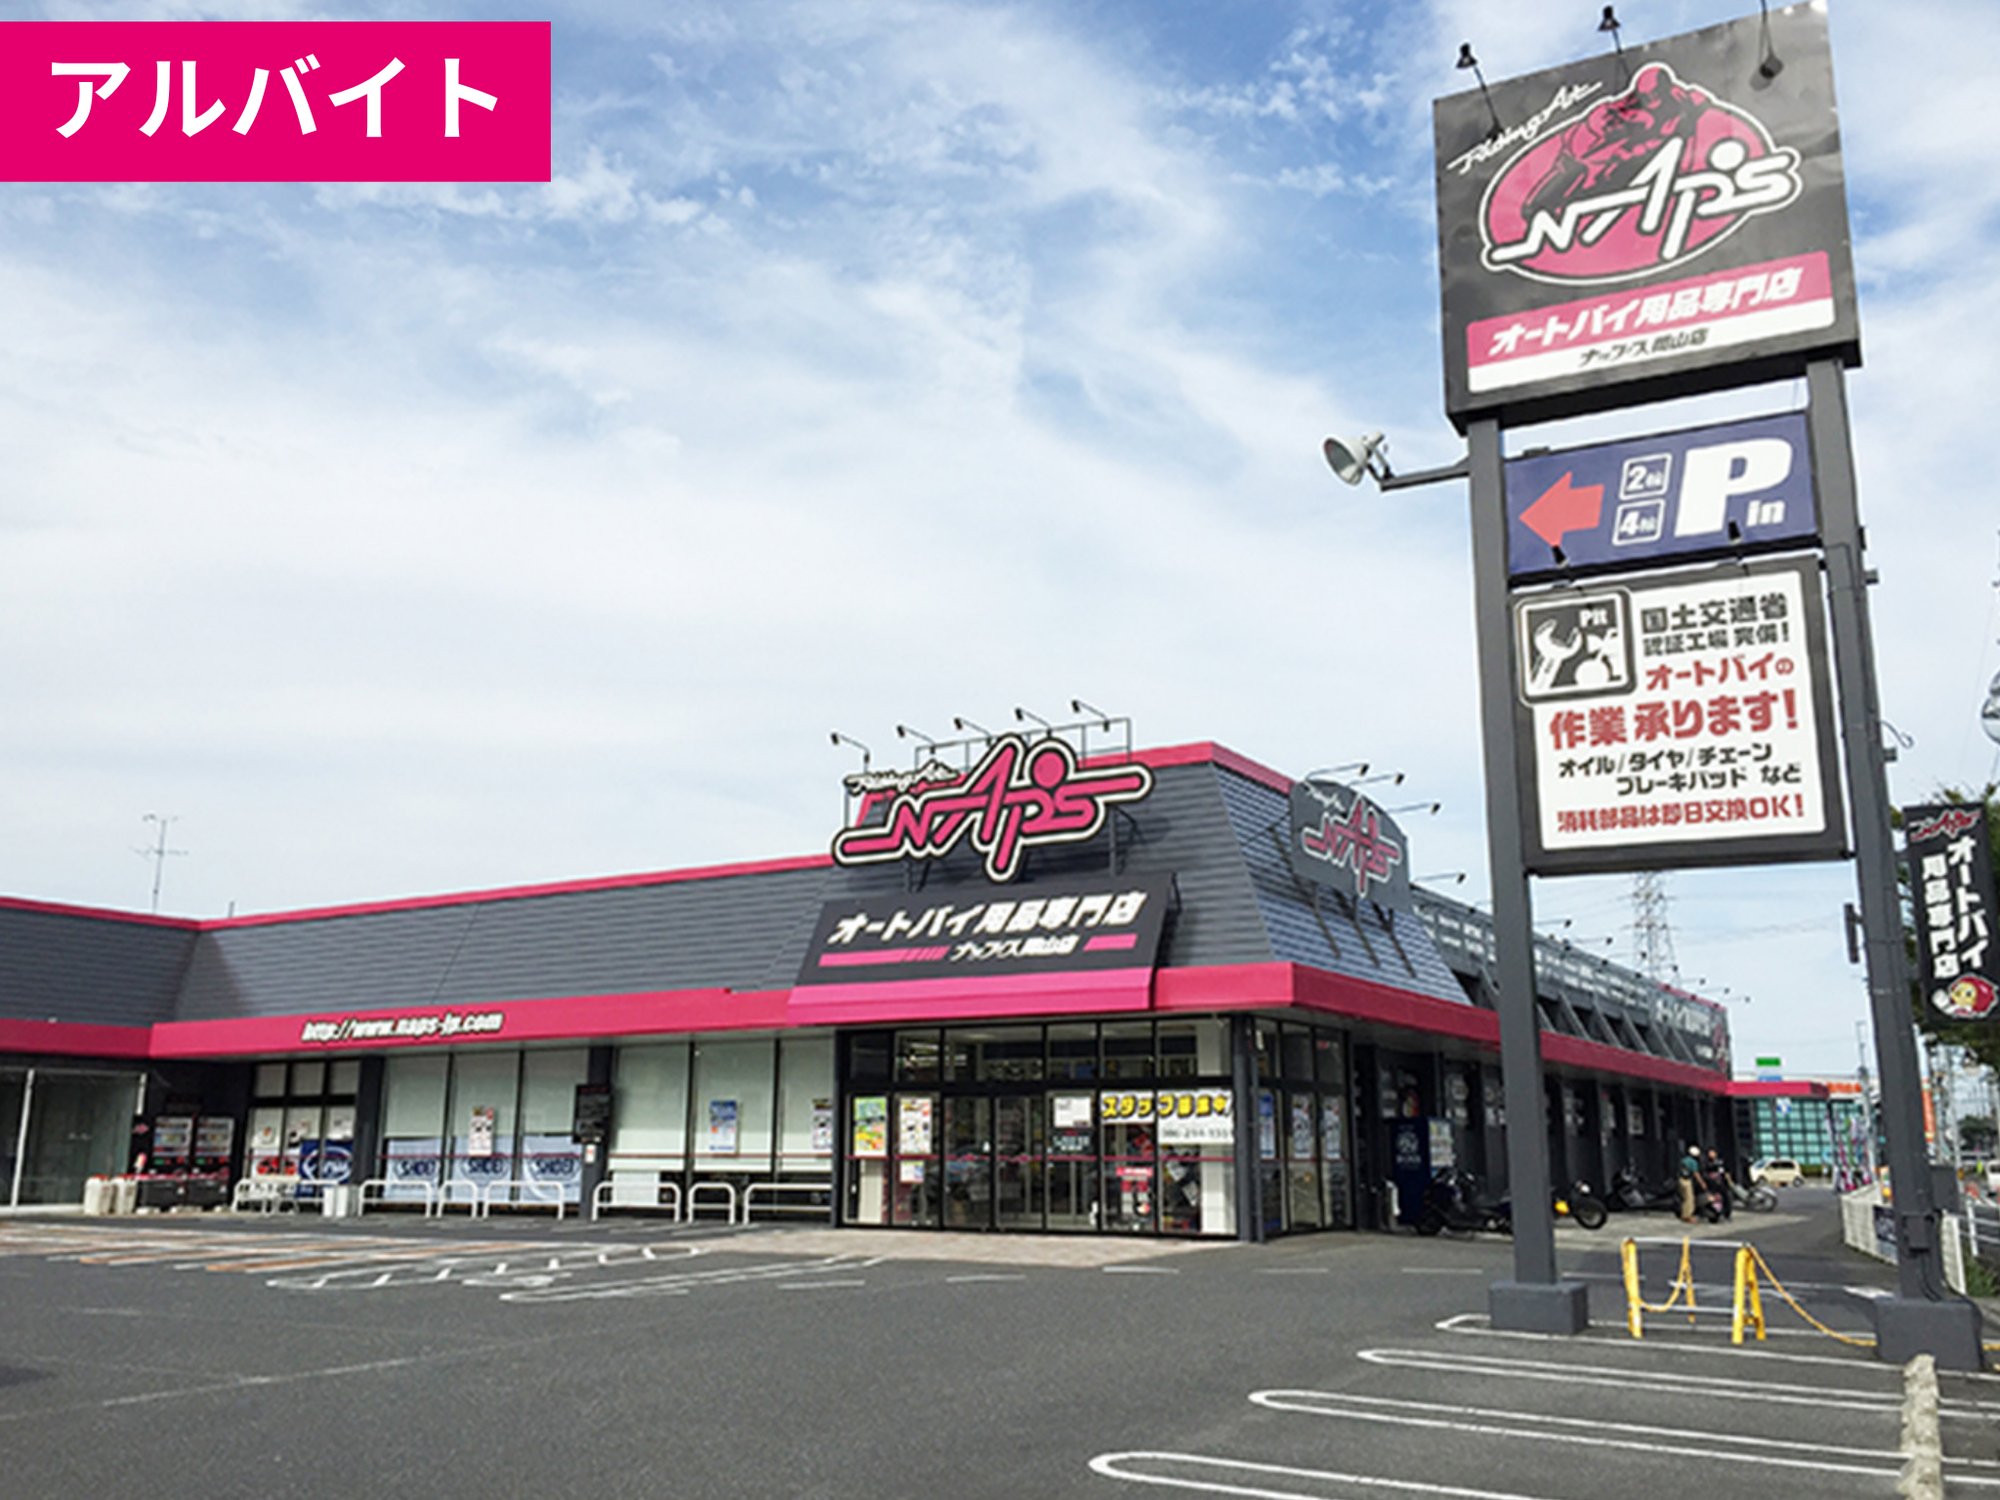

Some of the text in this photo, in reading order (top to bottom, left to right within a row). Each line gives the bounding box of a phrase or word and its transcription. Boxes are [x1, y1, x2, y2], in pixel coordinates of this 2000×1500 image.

[1488, 266, 1805, 357] オートバイ用品専門店
[1641, 592, 1788, 635] 国土交通省
[1645, 652, 1795, 691] オートバイの
[1548, 704, 1628, 750] 作業
[1760, 762, 1802, 786] など
[826, 890, 1148, 945] オートバイ用品専門店
[1947, 834, 1989, 969] オートバイ
